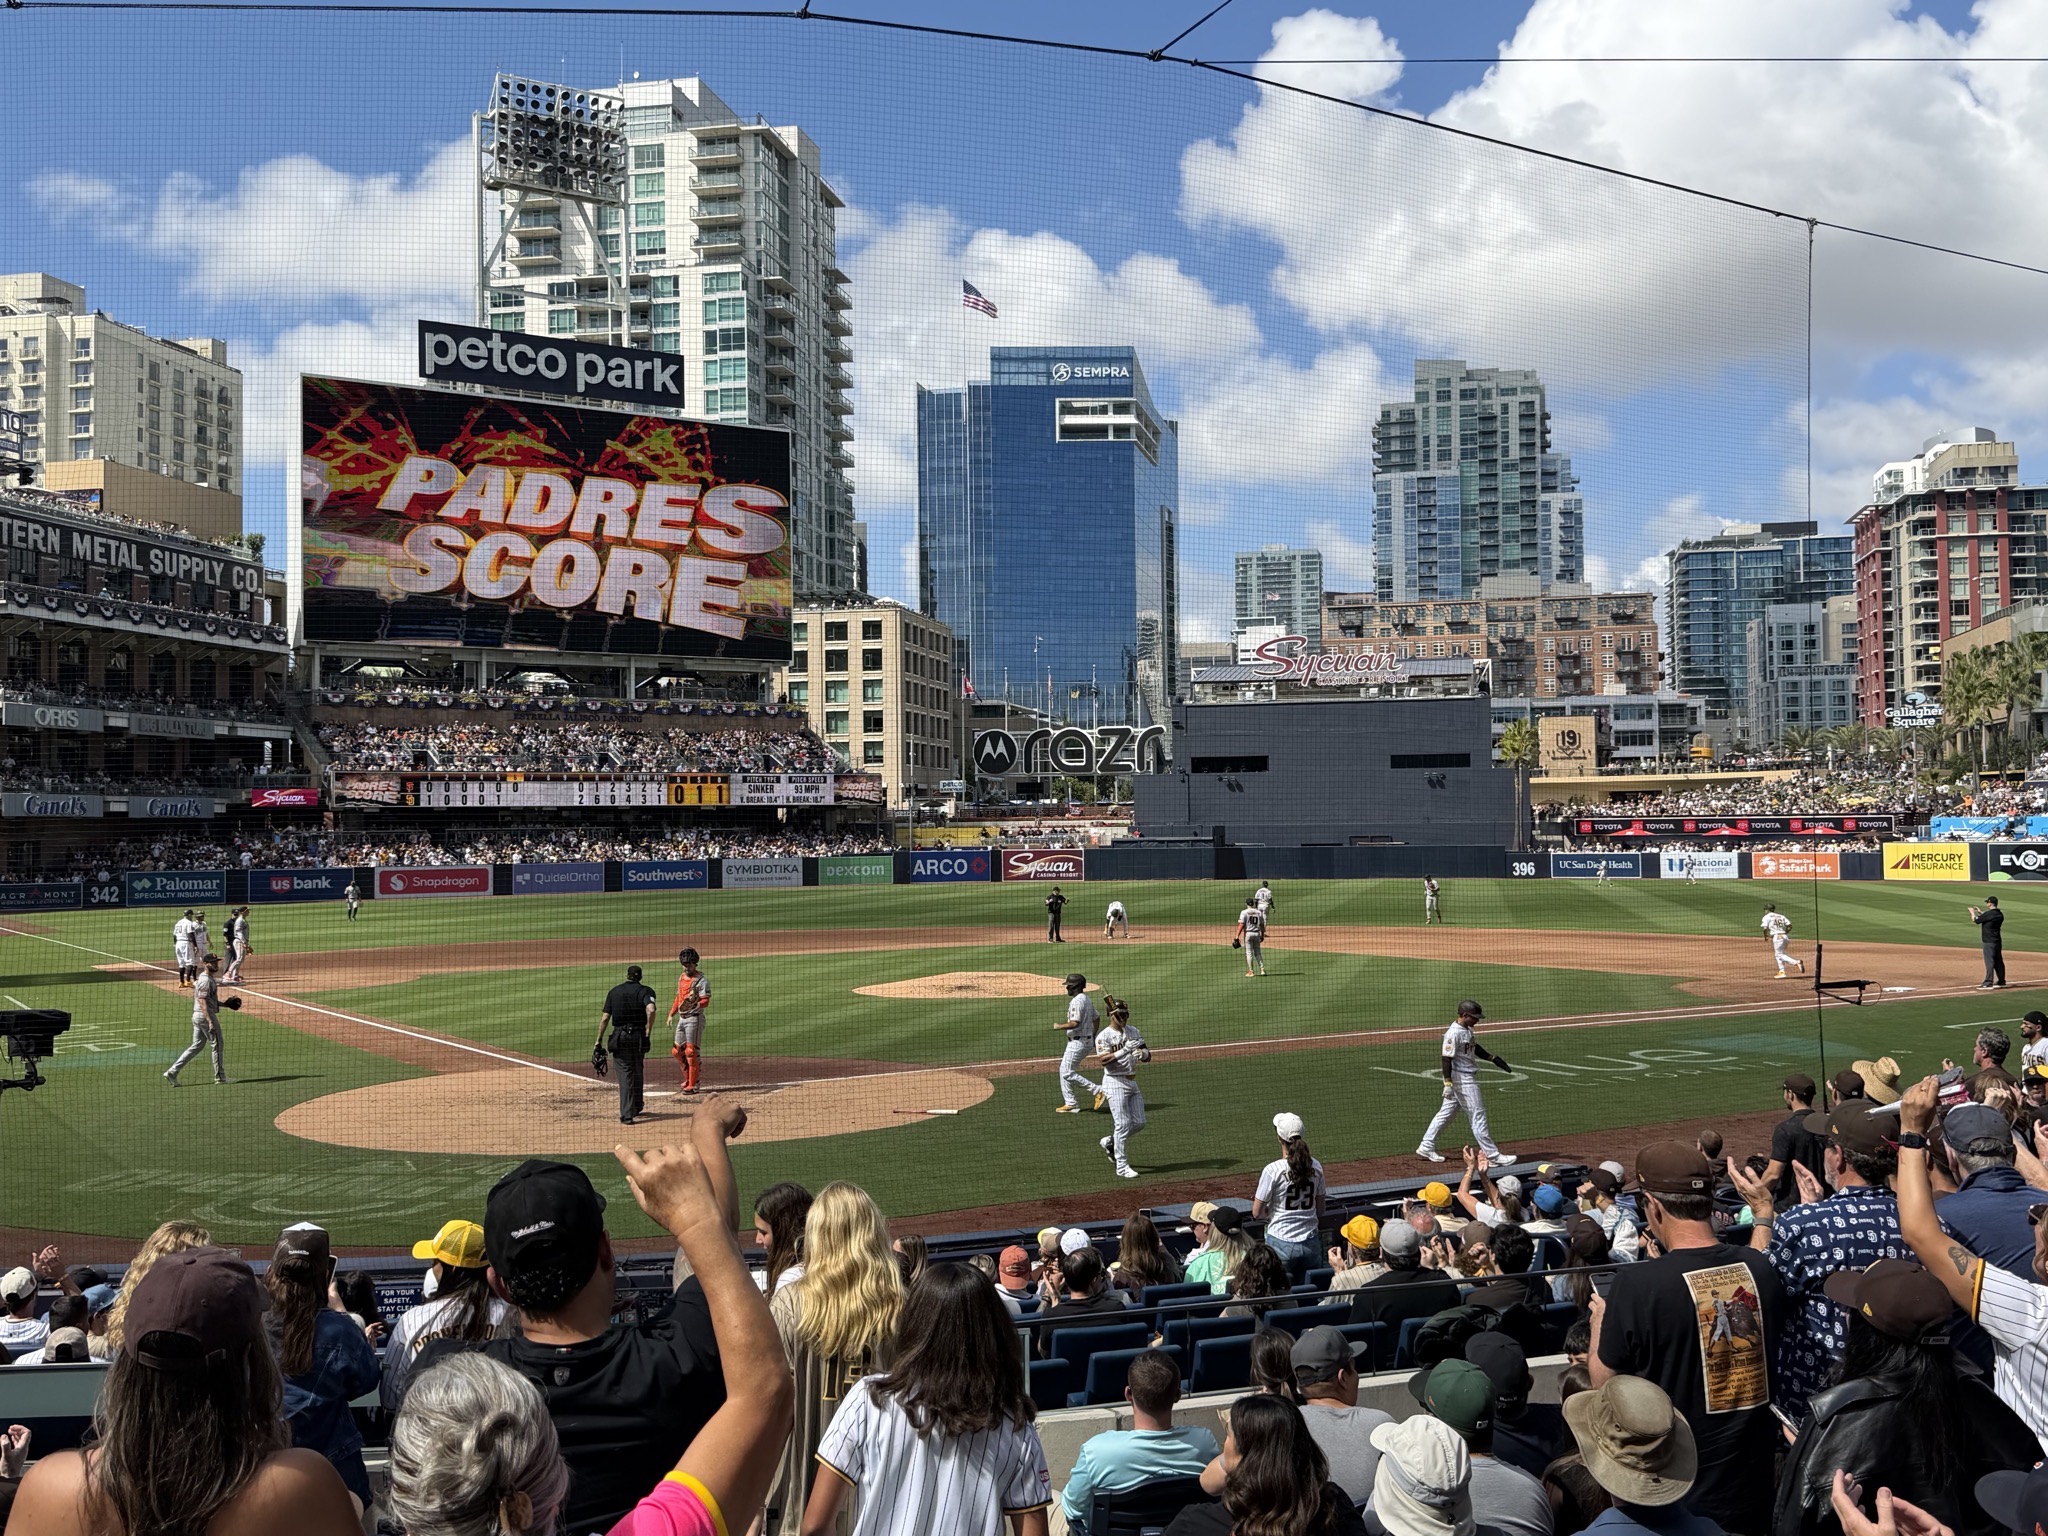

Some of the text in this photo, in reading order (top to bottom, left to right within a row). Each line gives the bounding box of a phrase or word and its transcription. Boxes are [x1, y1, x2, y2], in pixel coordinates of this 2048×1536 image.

[424, 330, 680, 394] petco park
[1073, 366, 1130, 378] SEMPRA
[376, 454, 789, 556] PADRES
[72, 532, 144, 572] METAL
[150, 550, 225, 586] SUPPLY
[232, 565, 263, 594] CO.
[387, 522, 749, 640] SCORE
[1252, 635, 1403, 687] Sycuan
[1316, 673, 1409, 686] CASINO RESORT
[35, 707, 80, 728] ORIS
[1884, 706, 1944, 720] Gallagher
[1892, 717, 1936, 729] Square
[1560, 729, 1576, 747] 19
[1022, 725, 1167, 776] razr
[426, 782, 432, 793] 0
[444, 782, 450, 793] 0
[462, 782, 467, 793] 0
[479, 782, 484, 793] 0
[496, 782, 501, 793] 0
[513, 782, 518, 793] 0
[578, 782, 584, 792] 0
[595, 782, 598, 792] 1
[610, 782, 615, 792] 2
[626, 782, 631, 792] 3
[641, 782, 646, 792] 2
[657, 782, 662, 792] 2
[674, 785, 722, 804] 0 1 1
[748, 784, 774, 794] SINKER
[794, 784, 820, 794] 93 MPH
[263, 790, 305, 805] Sycuan
[427, 795, 431, 805] 1
[444, 795, 450, 805] 0
[462, 795, 467, 805] 0
[479, 795, 484, 805] 0
[497, 795, 500, 805] 1
[578, 795, 584, 804] 2
[594, 795, 600, 804] 6
[610, 795, 615, 804] 0
[626, 795, 631, 804] 4
[641, 795, 646, 804] 3
[657, 795, 661, 804] 1
[24, 795, 87, 817] Canel's
[147, 797, 200, 818] Canel's
[1559, 860, 1571, 868] UC
[1572, 860, 1586, 868] San
[1608, 860, 1633, 869] Health
[1911, 853, 1962, 862] MERCURY
[725, 864, 799, 875] CYMBIOTIKA
[912, 858, 968, 875] ARCO
[1009, 853, 1076, 879] Sycuan
[1512, 862, 1535, 876] 396
[1779, 864, 1832, 873] Safari Park
[1911, 861, 1964, 871] INSURANCE
[412, 875, 480, 888] Snapdragon
[534, 871, 600, 883] QuidelOrtho
[628, 868, 694, 882] Southwest
[154, 877, 220, 891] Palomar
[293, 876, 331, 889] bank
[90, 886, 119, 903] 342
[134, 890, 220, 900] SPECIALTY INSURANCE
[1285, 1181, 1315, 1210] 23
[377, 1304, 418, 1313] STAY CLEA
